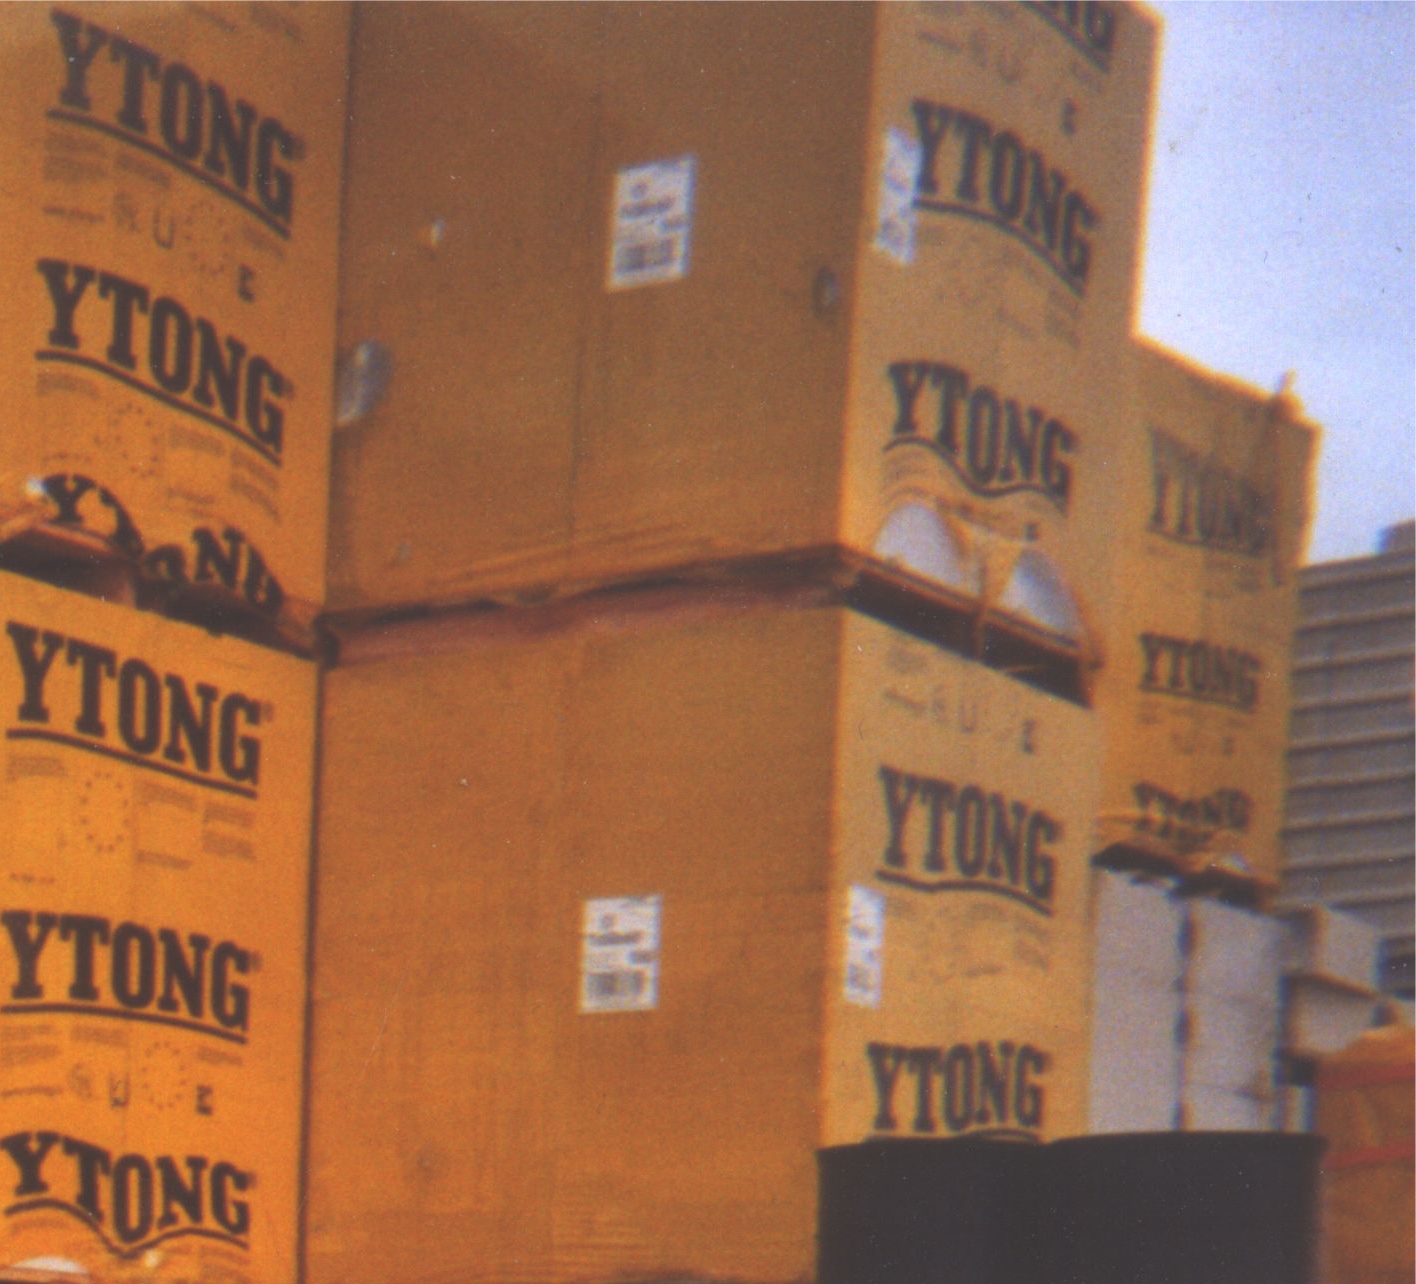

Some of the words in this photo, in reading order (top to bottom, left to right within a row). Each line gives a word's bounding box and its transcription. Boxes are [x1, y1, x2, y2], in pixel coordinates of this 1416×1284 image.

[49, 7, 300, 224] YTONG
[910, 98, 1099, 281] YTONG
[36, 257, 289, 456] YTONG
[887, 360, 1079, 501] YTONG
[5, 621, 263, 787] YTONG
[1140, 632, 1264, 713] YTONG
[877, 766, 1064, 901] YTONG
[0, 909, 251, 1034] YTONG
[865, 1041, 1053, 1133] YTONG
